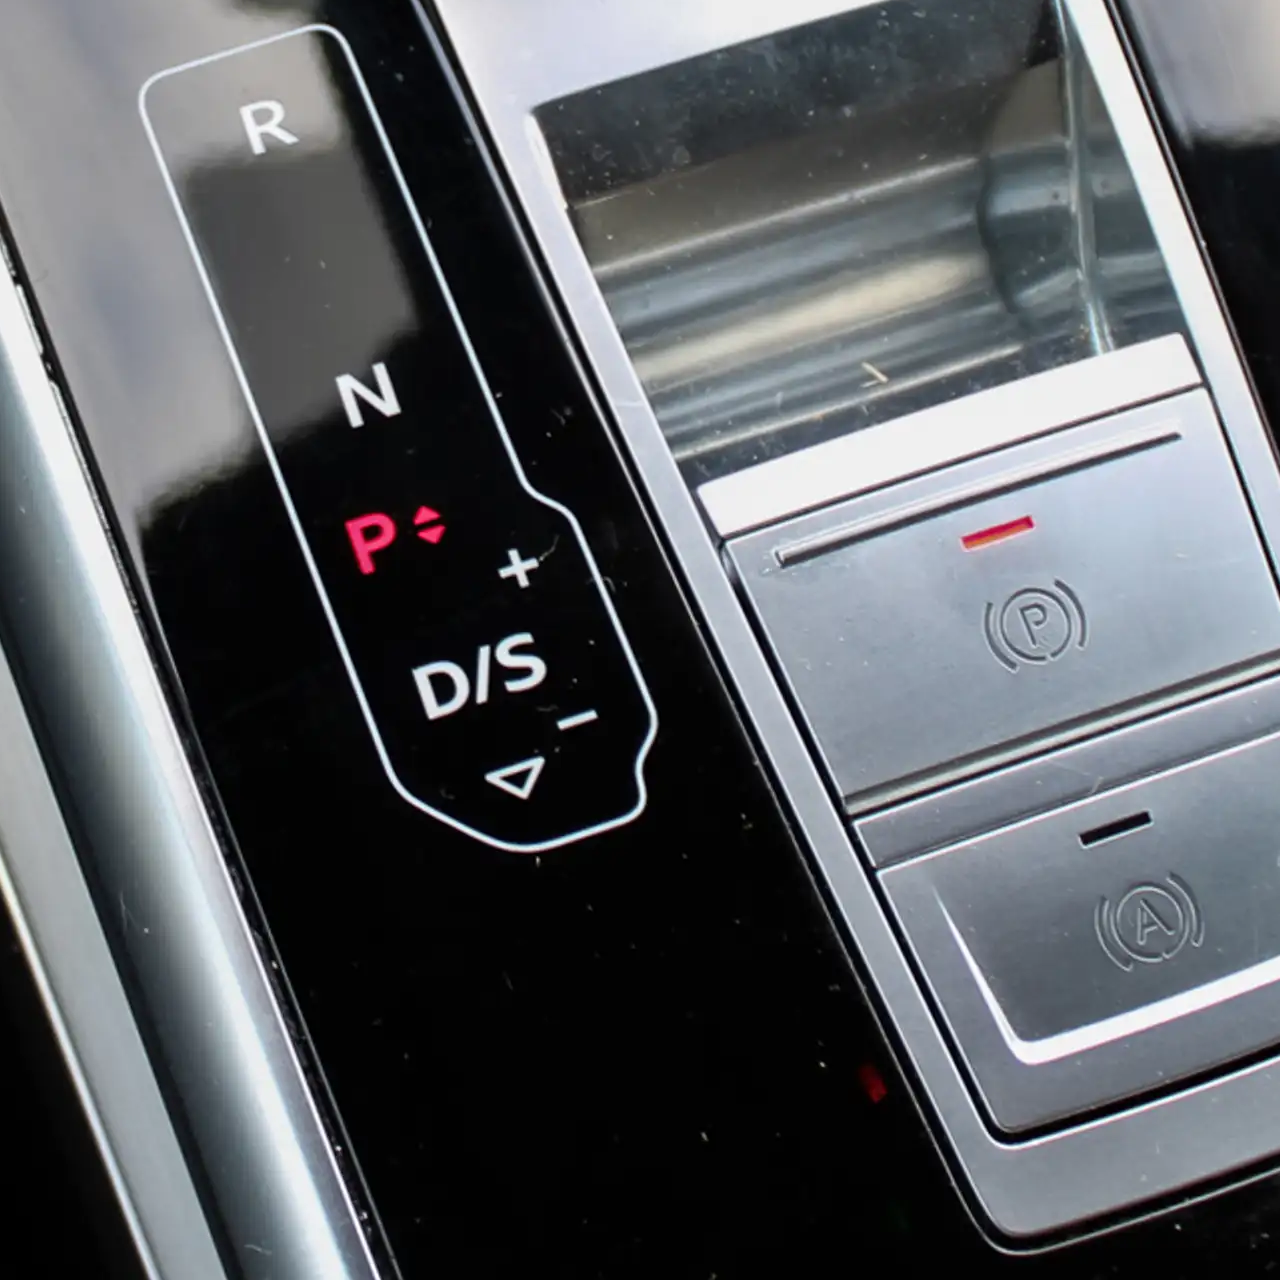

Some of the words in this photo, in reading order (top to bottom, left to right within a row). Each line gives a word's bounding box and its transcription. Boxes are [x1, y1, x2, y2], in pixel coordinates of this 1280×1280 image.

[239, 98, 300, 155] R
[335, 361, 402, 429] N
[344, 512, 397, 575] P
[412, 632, 548, 721] D/S
